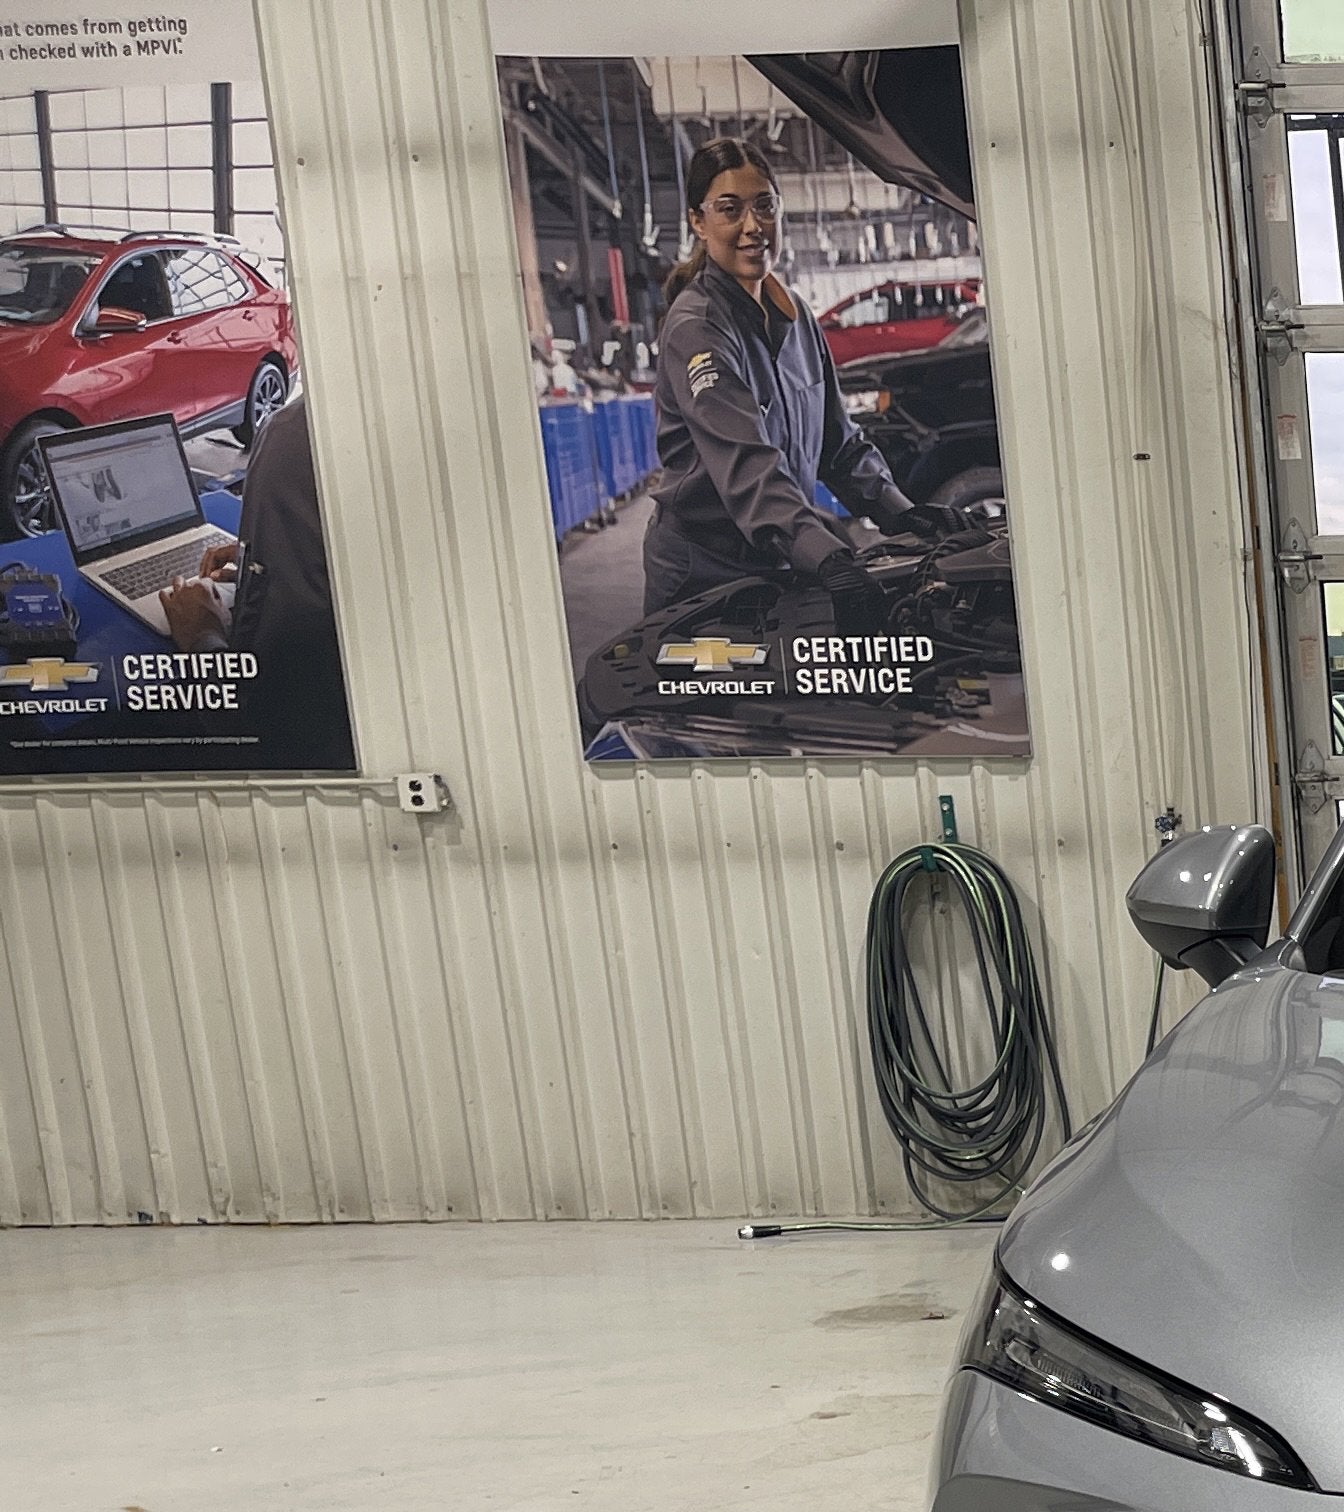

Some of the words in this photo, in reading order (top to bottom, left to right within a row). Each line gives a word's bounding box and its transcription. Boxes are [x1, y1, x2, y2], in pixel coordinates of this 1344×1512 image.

[25, 23, 78, 36] comes
[83, 19, 123, 35] from
[128, 16, 188, 37] getting
[9, 43, 77, 60] checked
[81, 41, 118, 58] with
[123, 44, 132, 56] a
[792, 636, 934, 663] CERTIFIED
[122, 652, 259, 681] CERTIFIED
[658, 680, 776, 695] CHEVROLET
[796, 667, 914, 695] SERVICE
[0, 698, 109, 716] CHEVROLET
[127, 683, 239, 711] SERVICE
